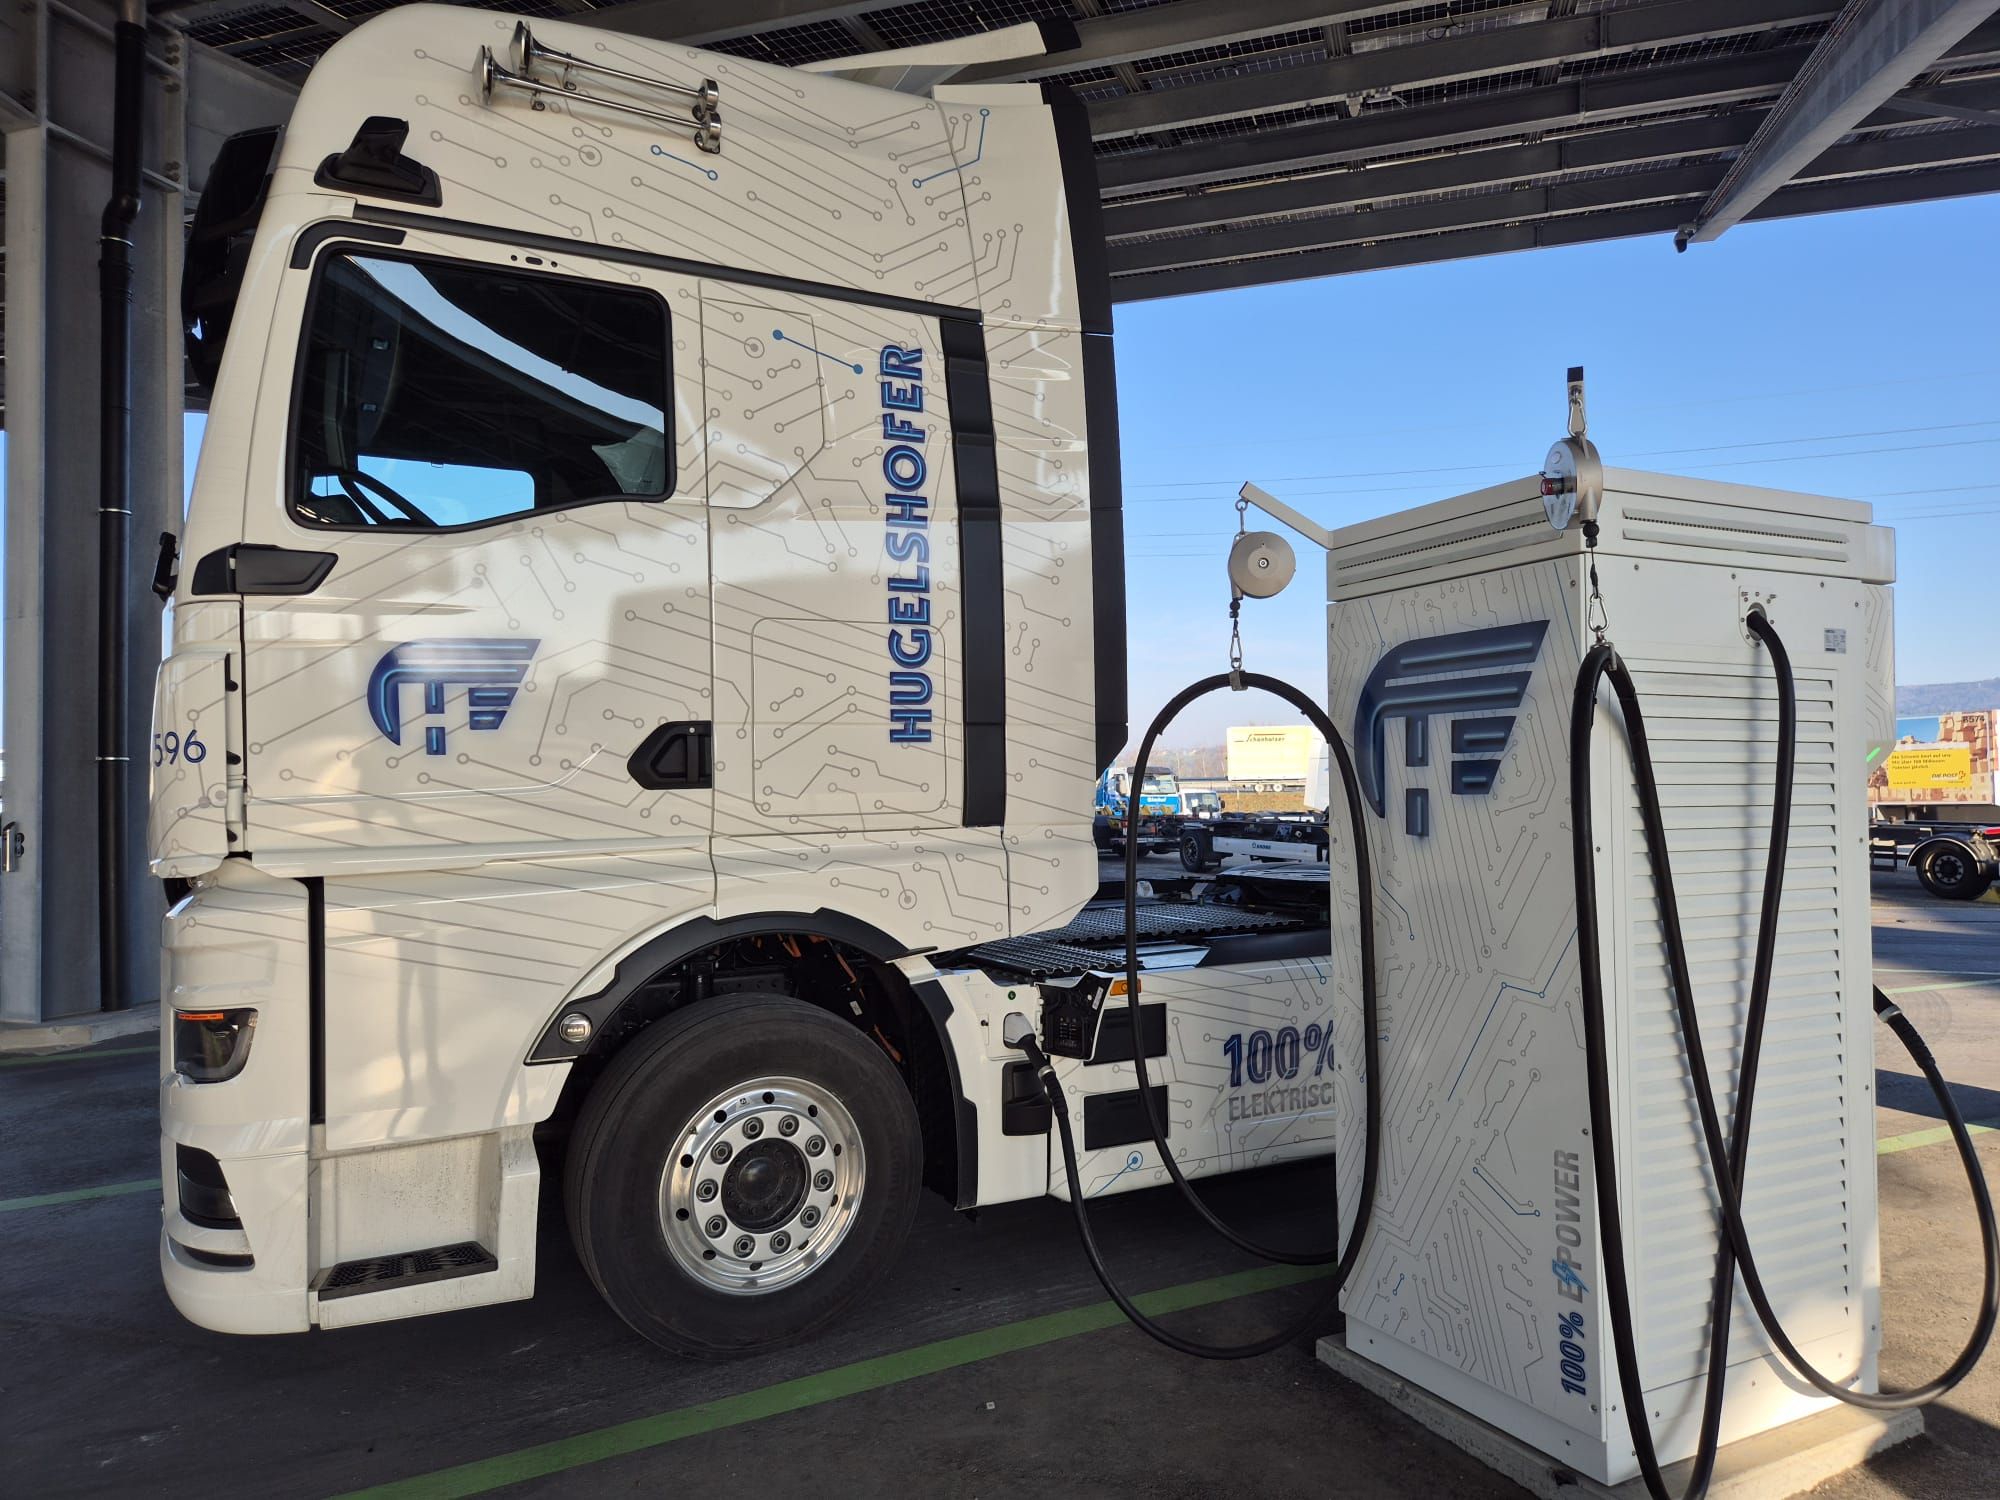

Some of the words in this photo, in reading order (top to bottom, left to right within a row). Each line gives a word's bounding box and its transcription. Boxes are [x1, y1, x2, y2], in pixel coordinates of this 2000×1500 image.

[879, 343, 933, 743] HUGELSHOFER
[153, 729, 207, 767] 596
[1223, 1020, 1334, 1088] 100%
[1229, 1082, 1335, 1121] ELEKTRISC
[1558, 1311, 1587, 1396] 100%
